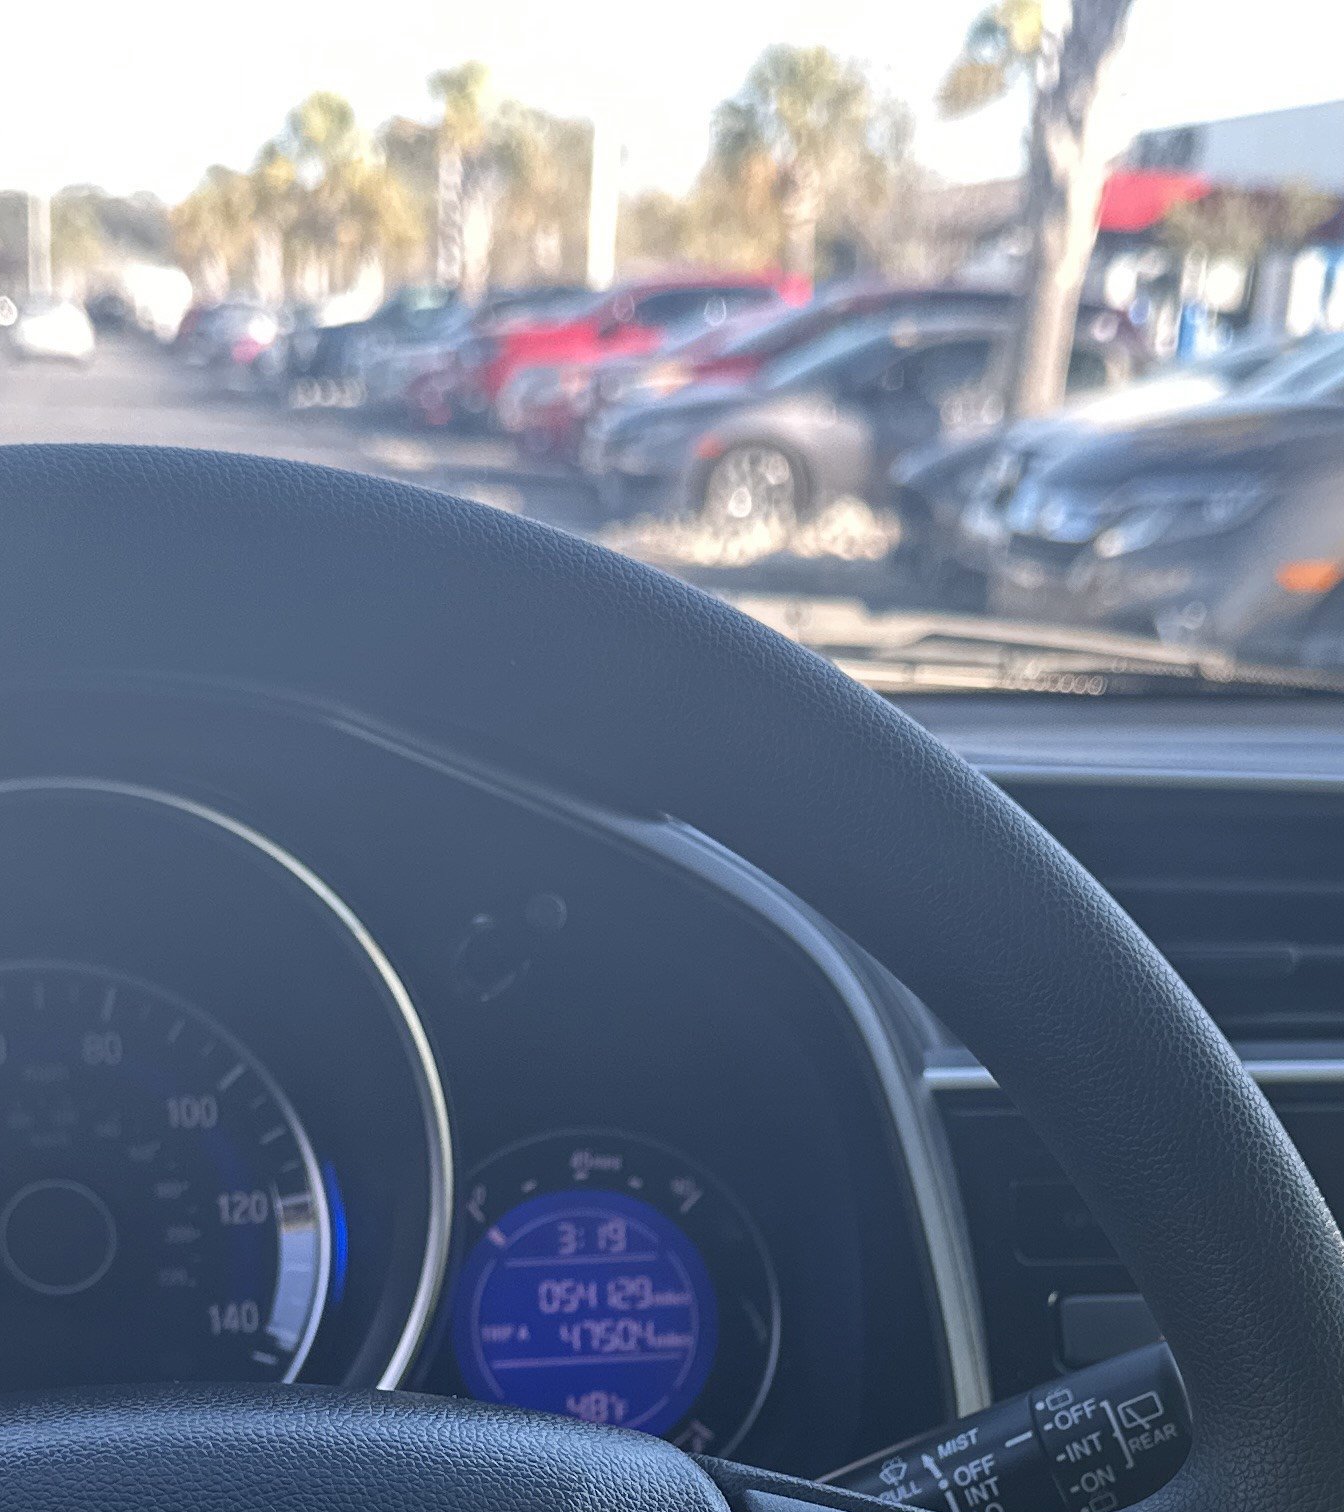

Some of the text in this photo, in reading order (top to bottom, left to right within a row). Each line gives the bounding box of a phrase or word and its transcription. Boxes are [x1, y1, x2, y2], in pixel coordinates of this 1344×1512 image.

[82, 1032, 123, 1065] 80
[166, 1095, 218, 1129] 100
[217, 1193, 269, 1226] 120
[538, 1275, 654, 1314] 054129
[207, 1302, 259, 1335] 140
[1054, 1398, 1097, 1431] OFF
[936, 1427, 980, 1460] MIST
[1065, 1431, 1104, 1463] INT
[1127, 1421, 1179, 1454] REAR
[954, 1453, 997, 1488] OFF
[1079, 1464, 1116, 1491] ON
[963, 1475, 1001, 1507] INT
